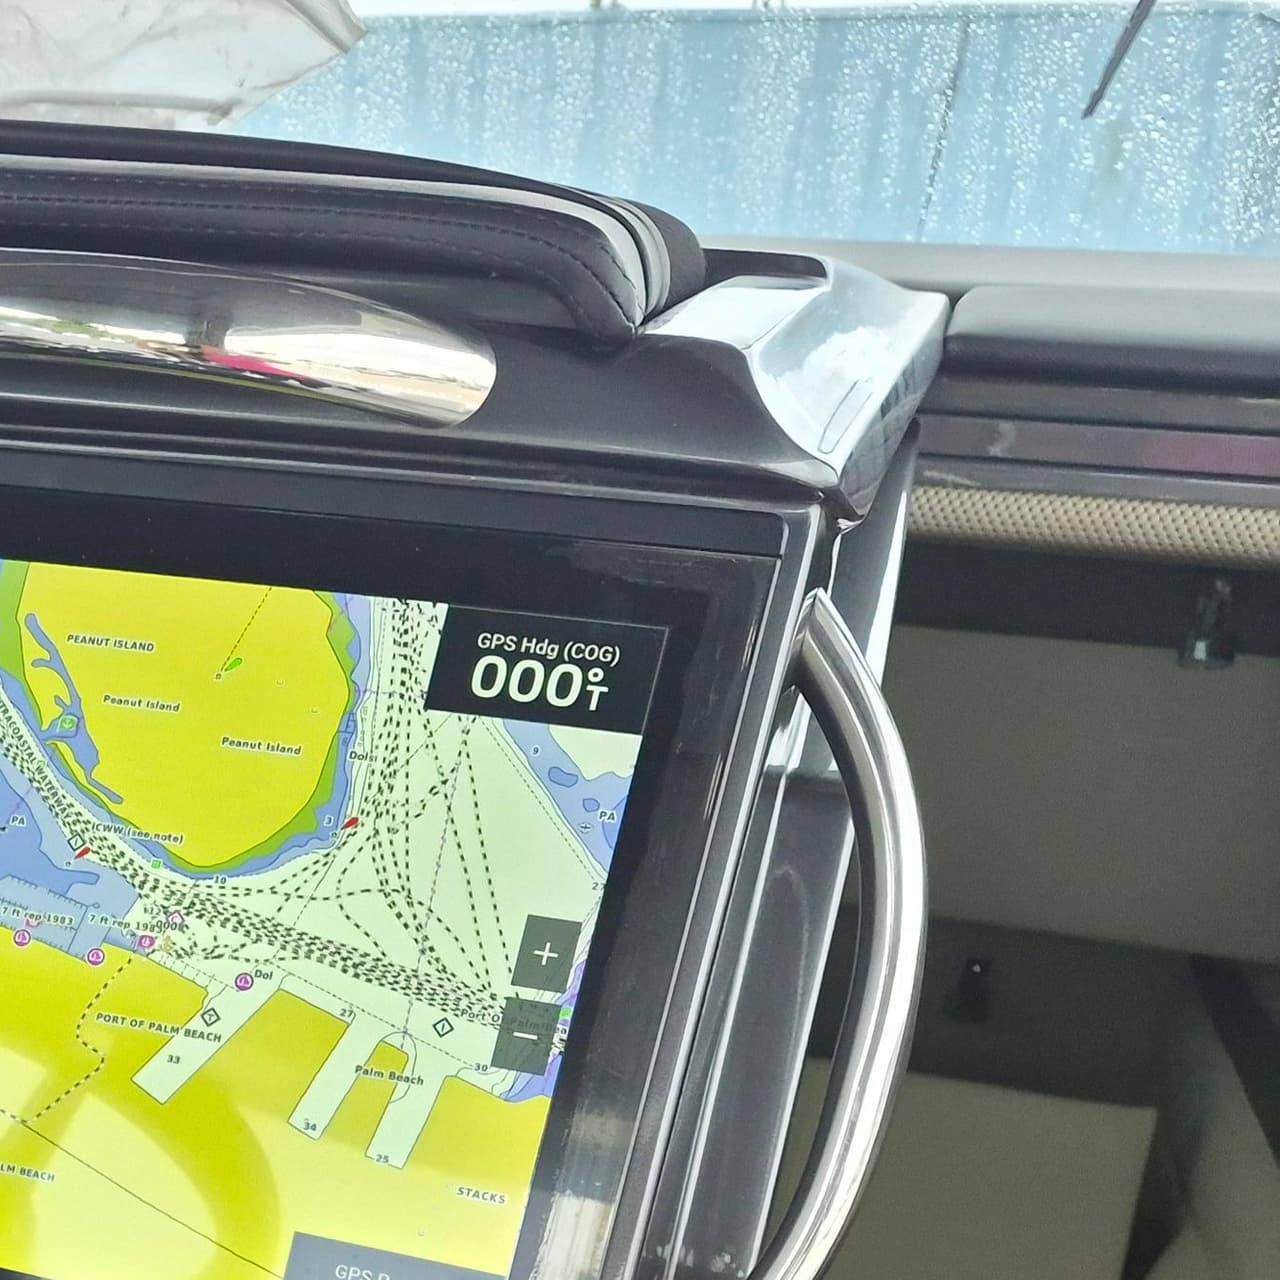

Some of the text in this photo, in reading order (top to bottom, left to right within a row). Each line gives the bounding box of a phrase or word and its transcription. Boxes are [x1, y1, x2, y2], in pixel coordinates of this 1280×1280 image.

[67, 634, 155, 652] PEANUT ISLAND
[477, 632, 621, 667] GPS Hdg (COG)
[103, 694, 181, 712] Peanut Island
[222, 736, 302, 755] Peanut Island
[532, 747, 539, 755] 9
[34, 763, 72, 823] WATERWAY
[12, 816, 26, 825] PA
[599, 811, 616, 821] PA
[92, 823, 184, 844] ICWW (see note)
[214, 875, 227, 884] 10
[12, 908, 21, 918] ft
[24, 911, 42, 921] rep
[46, 916, 73, 926] 1983
[100, 915, 109, 925] ft
[112, 919, 130, 929] rep
[254, 970, 273, 980] Dol
[340, 1009, 354, 1018] 27
[460, 1009, 486, 1021] Port
[96, 1013, 222, 1043] PORT OF PALM BEACH
[167, 1055, 181, 1064] 33
[475, 1063, 488, 1072] 30
[355, 1065, 424, 1085] Palm Beach
[304, 1122, 317, 1131] 34
[376, 1154, 389, 1163] 25
[20, 1167, 55, 1182] BEACH
[457, 1186, 506, 1204] STACKS
